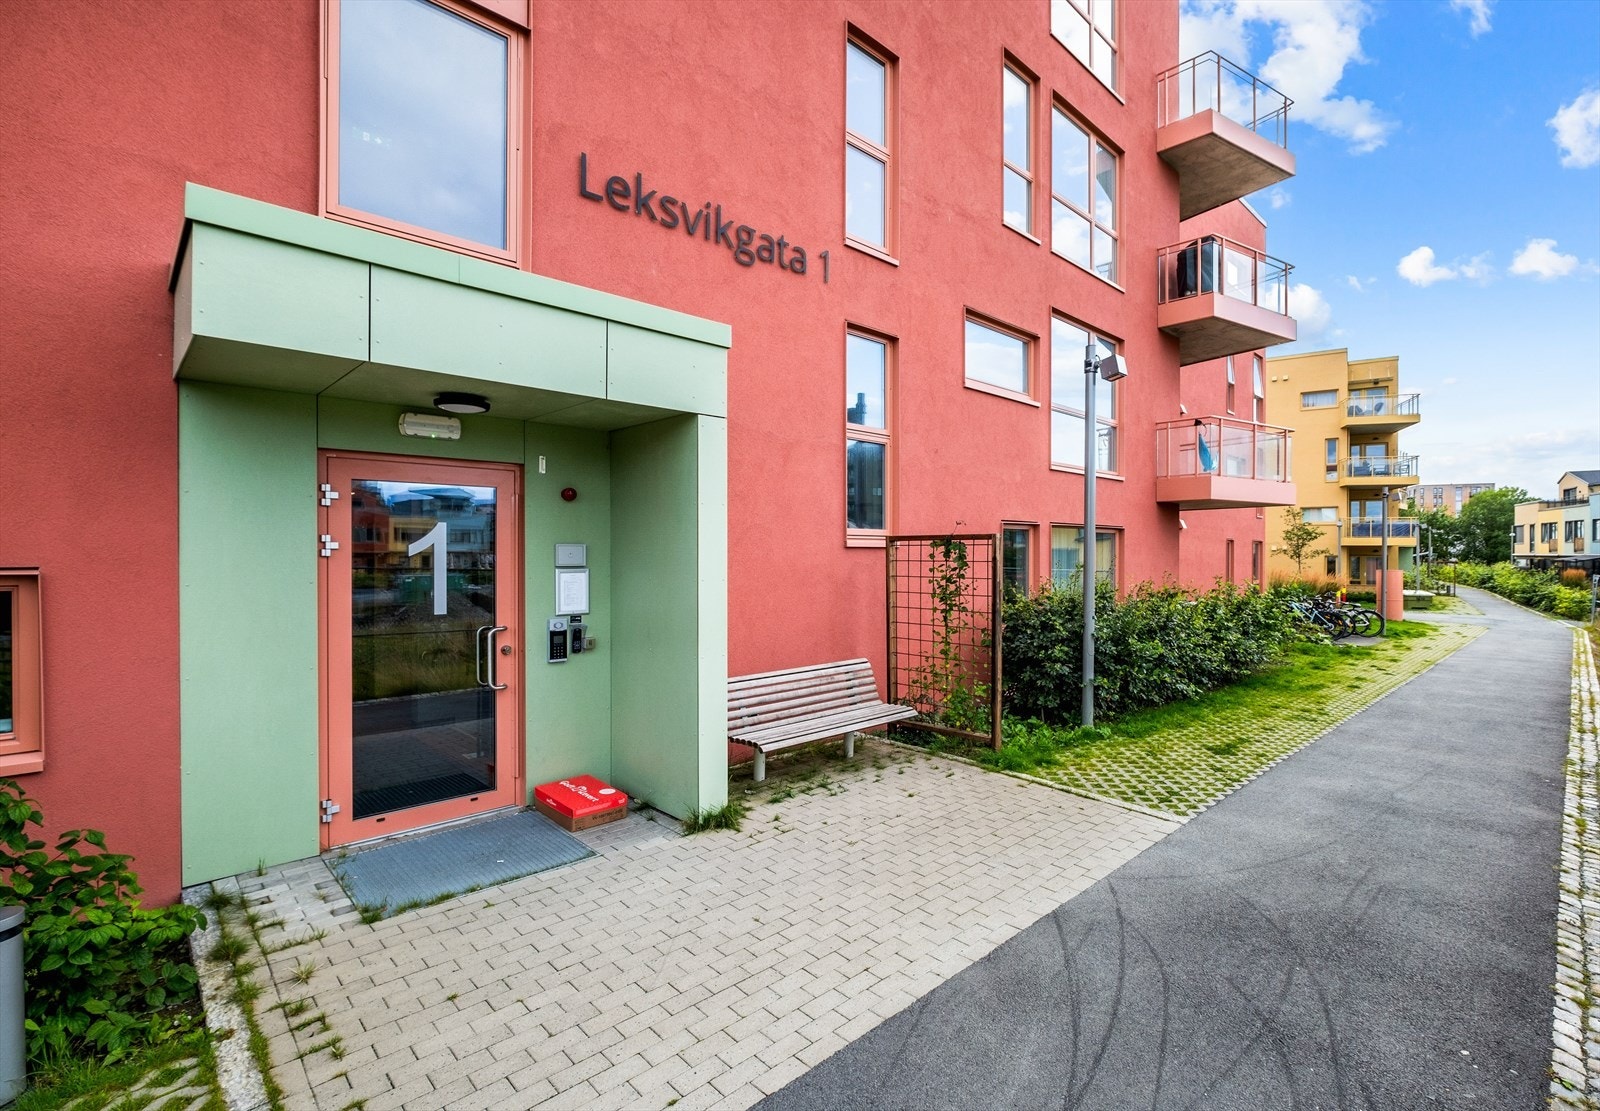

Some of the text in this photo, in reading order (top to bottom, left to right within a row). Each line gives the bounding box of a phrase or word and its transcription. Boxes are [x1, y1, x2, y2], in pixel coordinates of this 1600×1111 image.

[579, 152, 830, 283] Leksvikgata 1
[408, 522, 447, 615] 1
